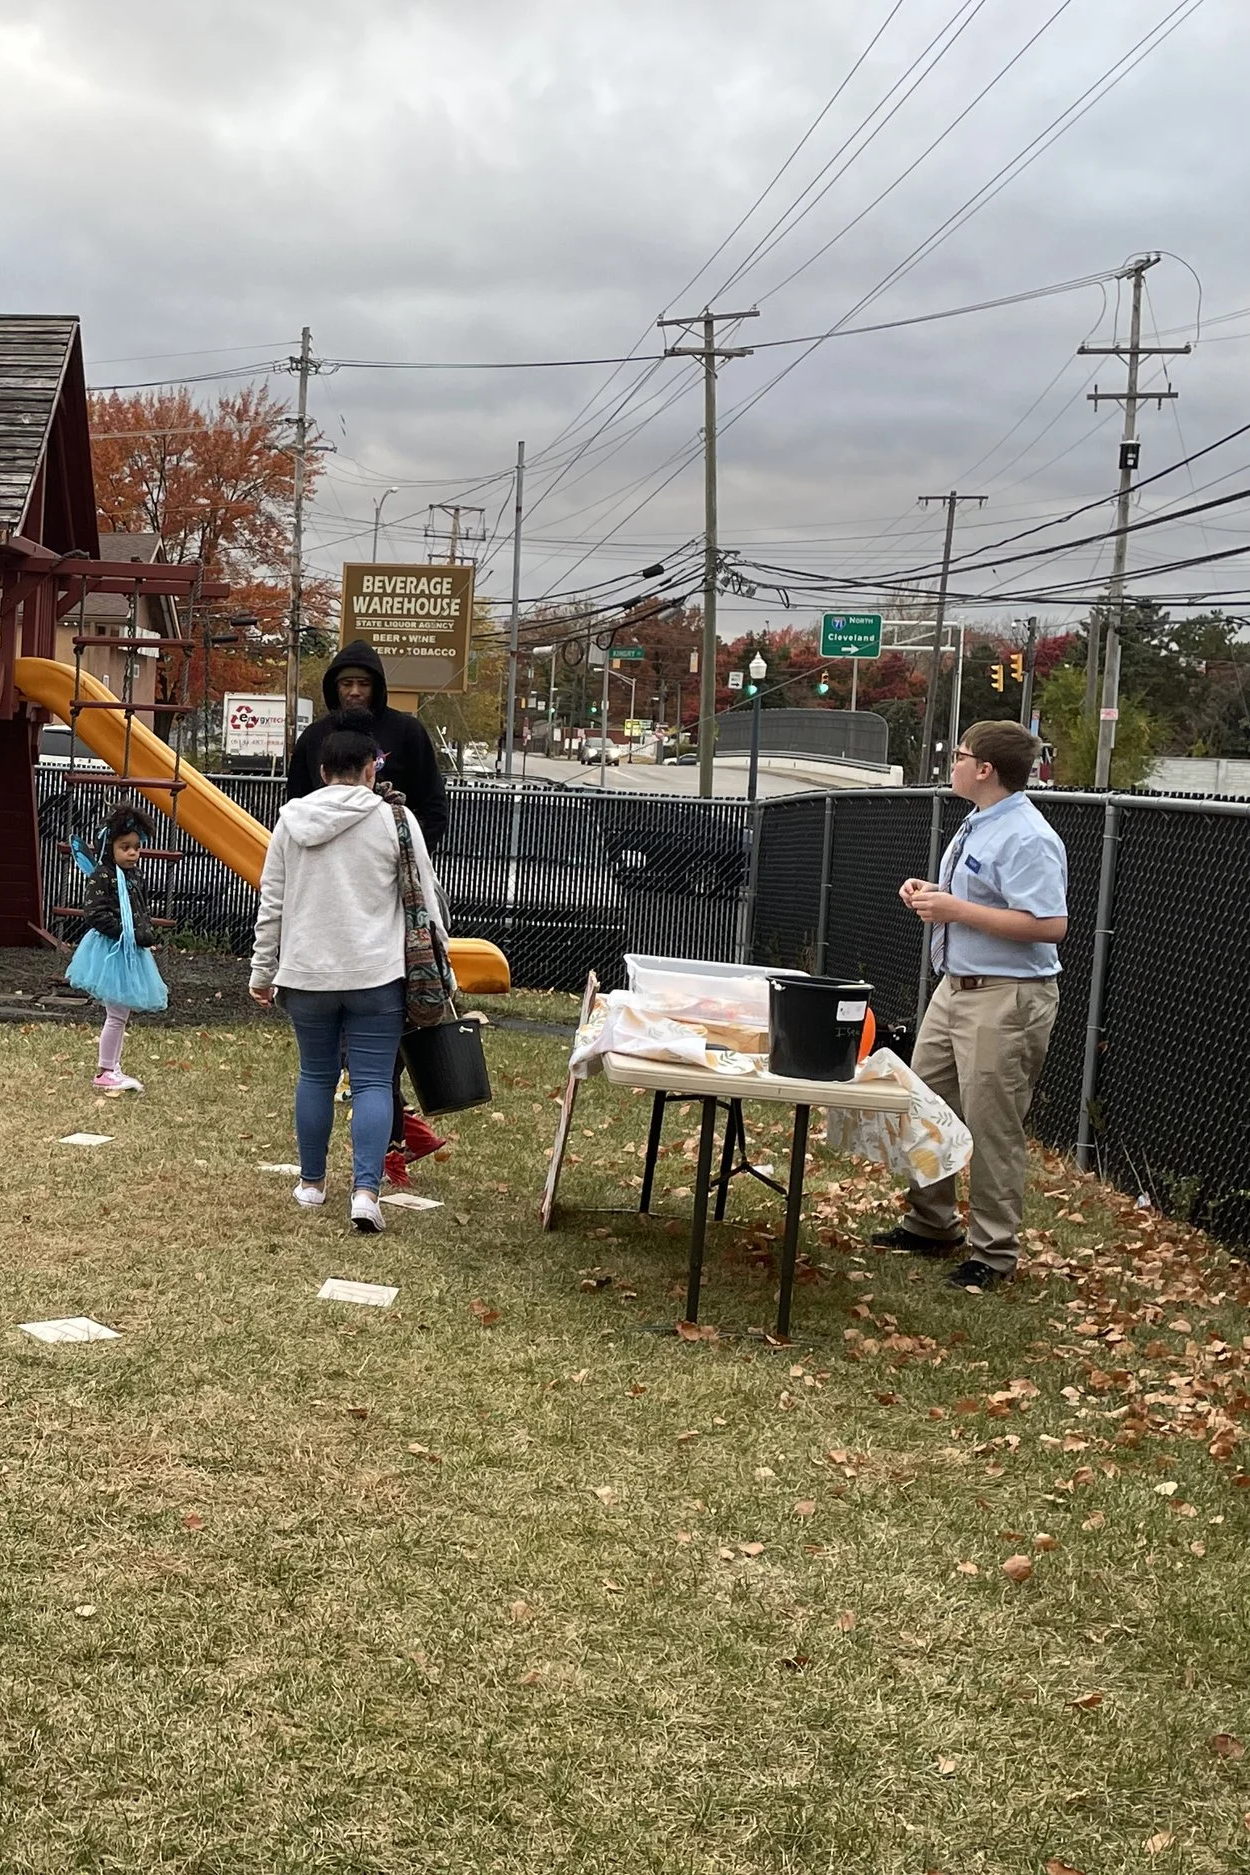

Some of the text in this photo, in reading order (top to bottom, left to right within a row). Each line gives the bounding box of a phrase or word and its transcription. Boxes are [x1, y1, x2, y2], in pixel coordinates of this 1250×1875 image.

[362, 575, 453, 595] BEVERAGE
[352, 596, 461, 616] WAREHOUSE
[355, 620, 382, 628] STATE
[384, 621, 417, 629] LIQUOR
[849, 616, 874, 624] NORTH
[372, 633, 436, 643] BEER WINE
[827, 633, 875, 642] Cleveland
[371, 646, 457, 657] TERY TOBACCO
